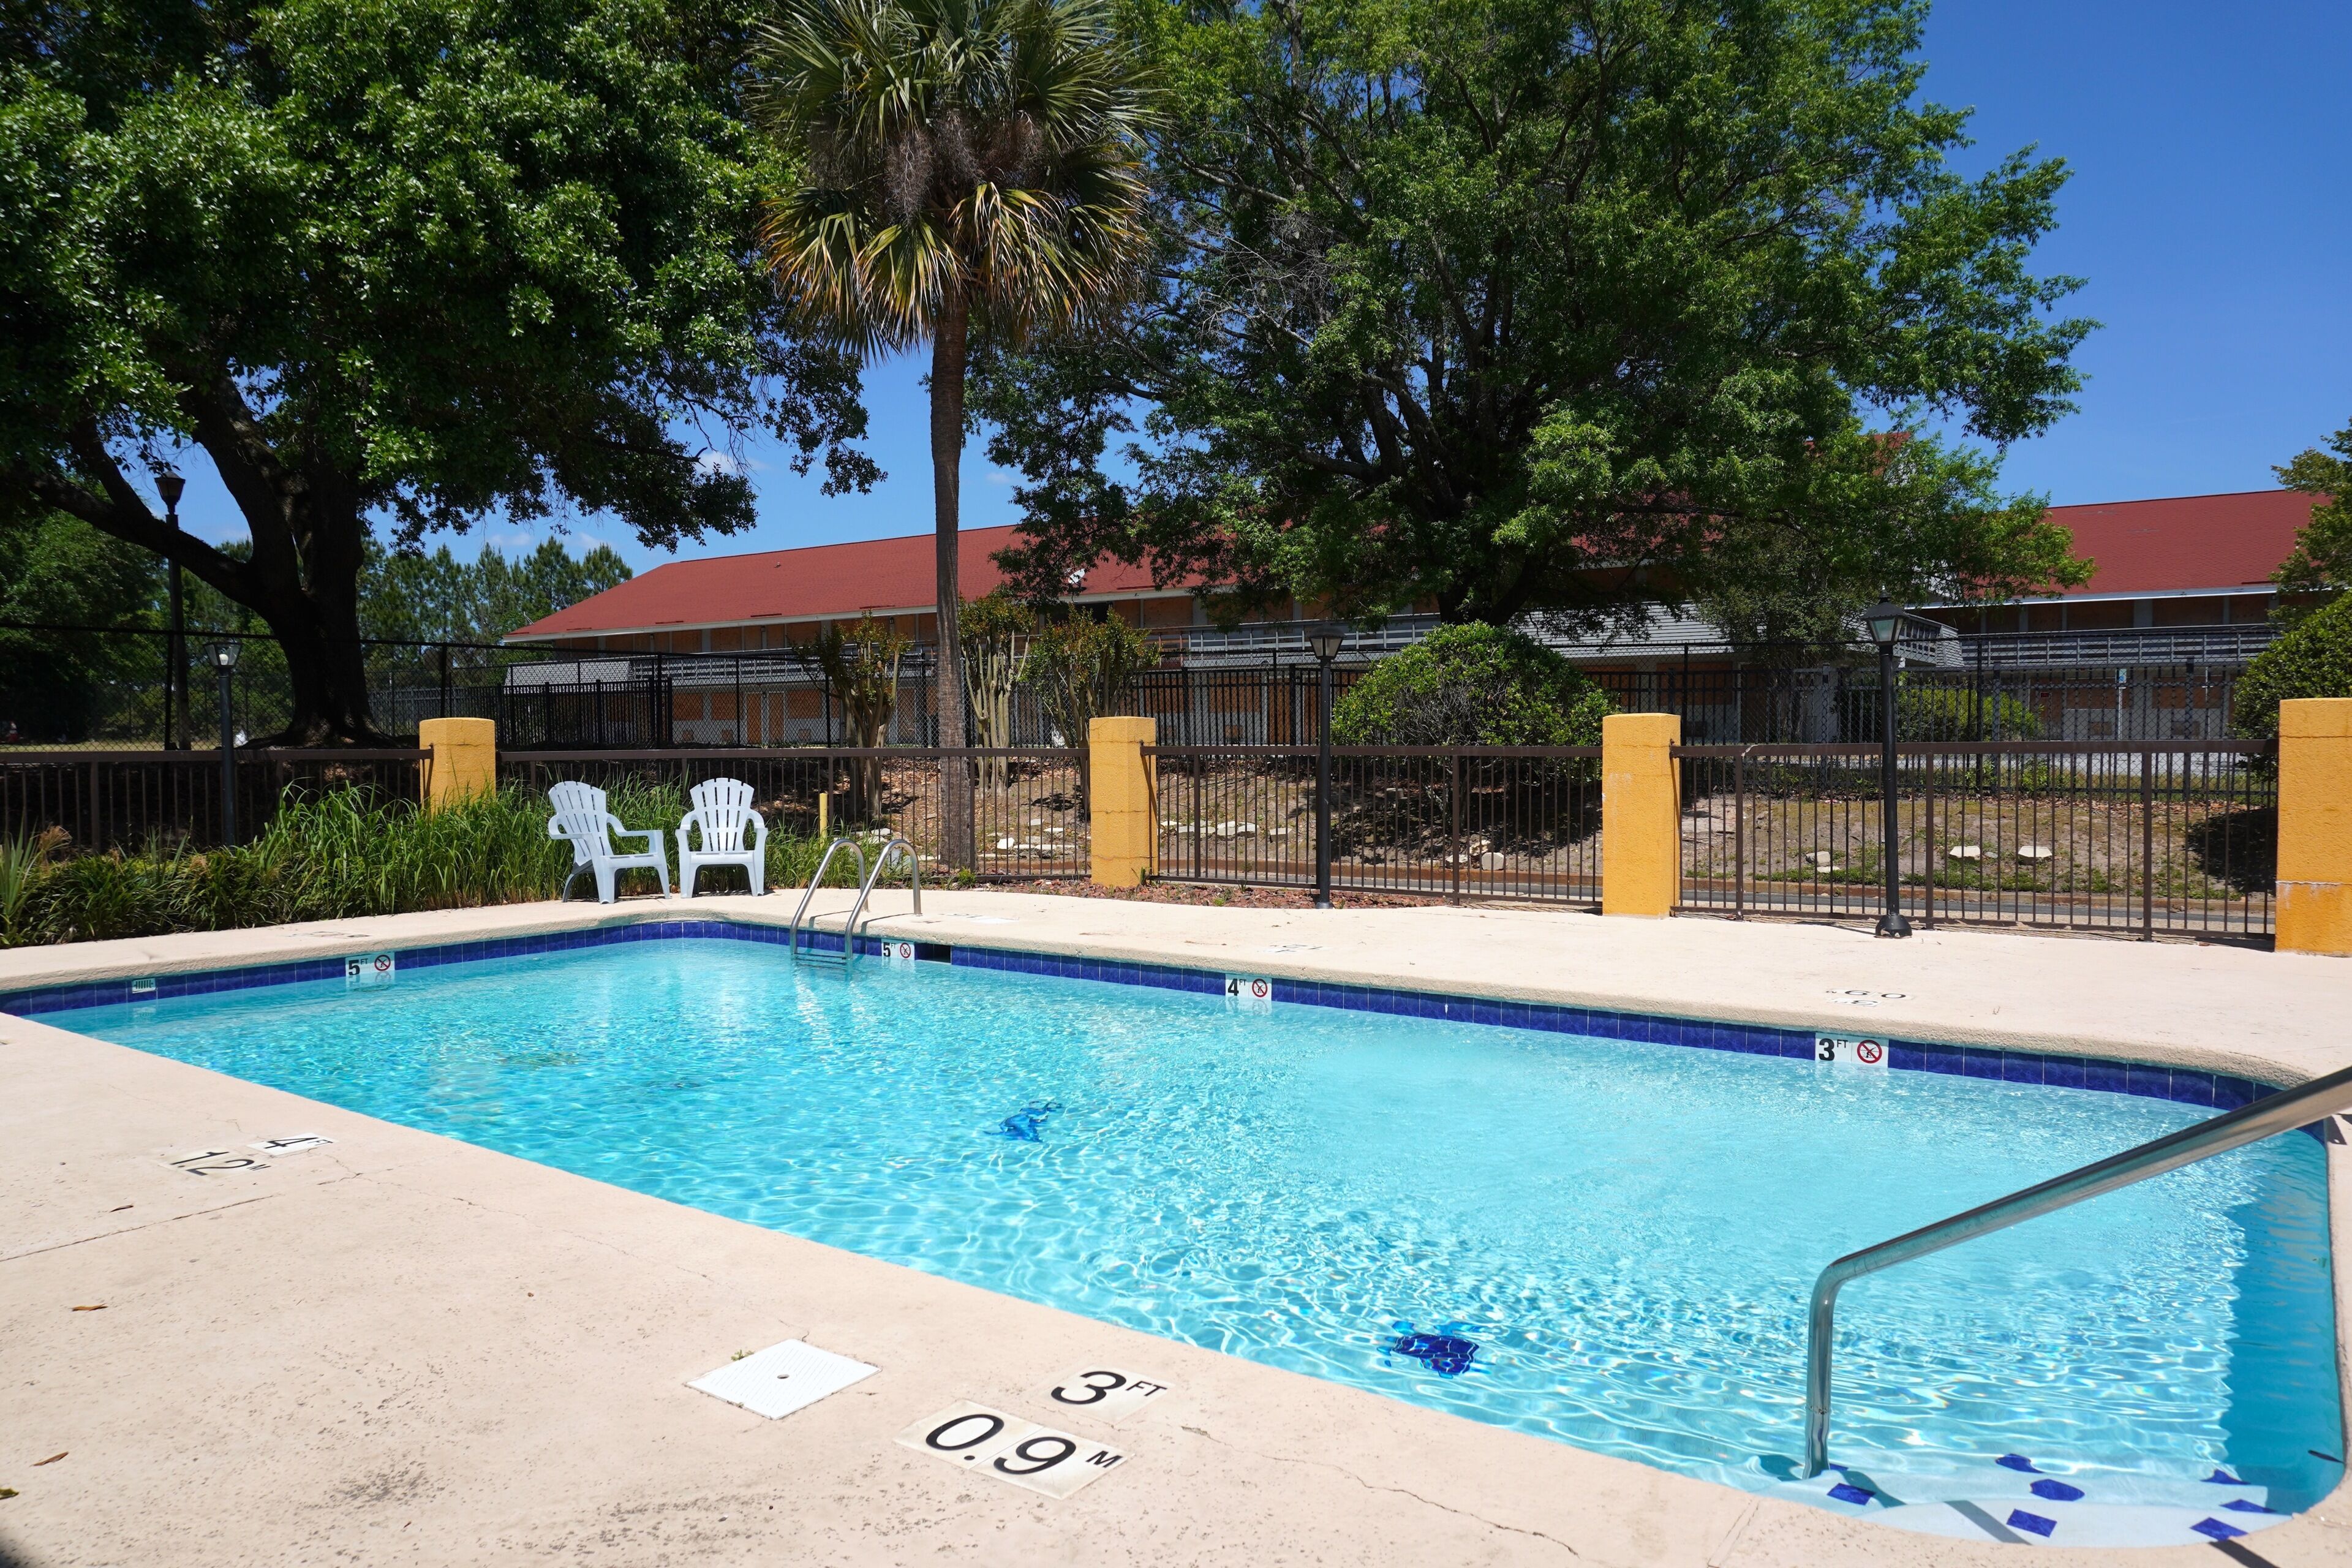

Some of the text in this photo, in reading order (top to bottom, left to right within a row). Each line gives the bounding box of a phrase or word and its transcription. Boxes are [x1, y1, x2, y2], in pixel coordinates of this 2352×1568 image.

[883, 942, 891, 957] 5
[349, 959, 360, 976] 5
[1228, 979, 1238, 996] 4
[1819, 1038, 1835, 1061] 3
[1050, 1370, 1127, 1405] 3
[925, 1414, 1123, 1476] 0.9 M
